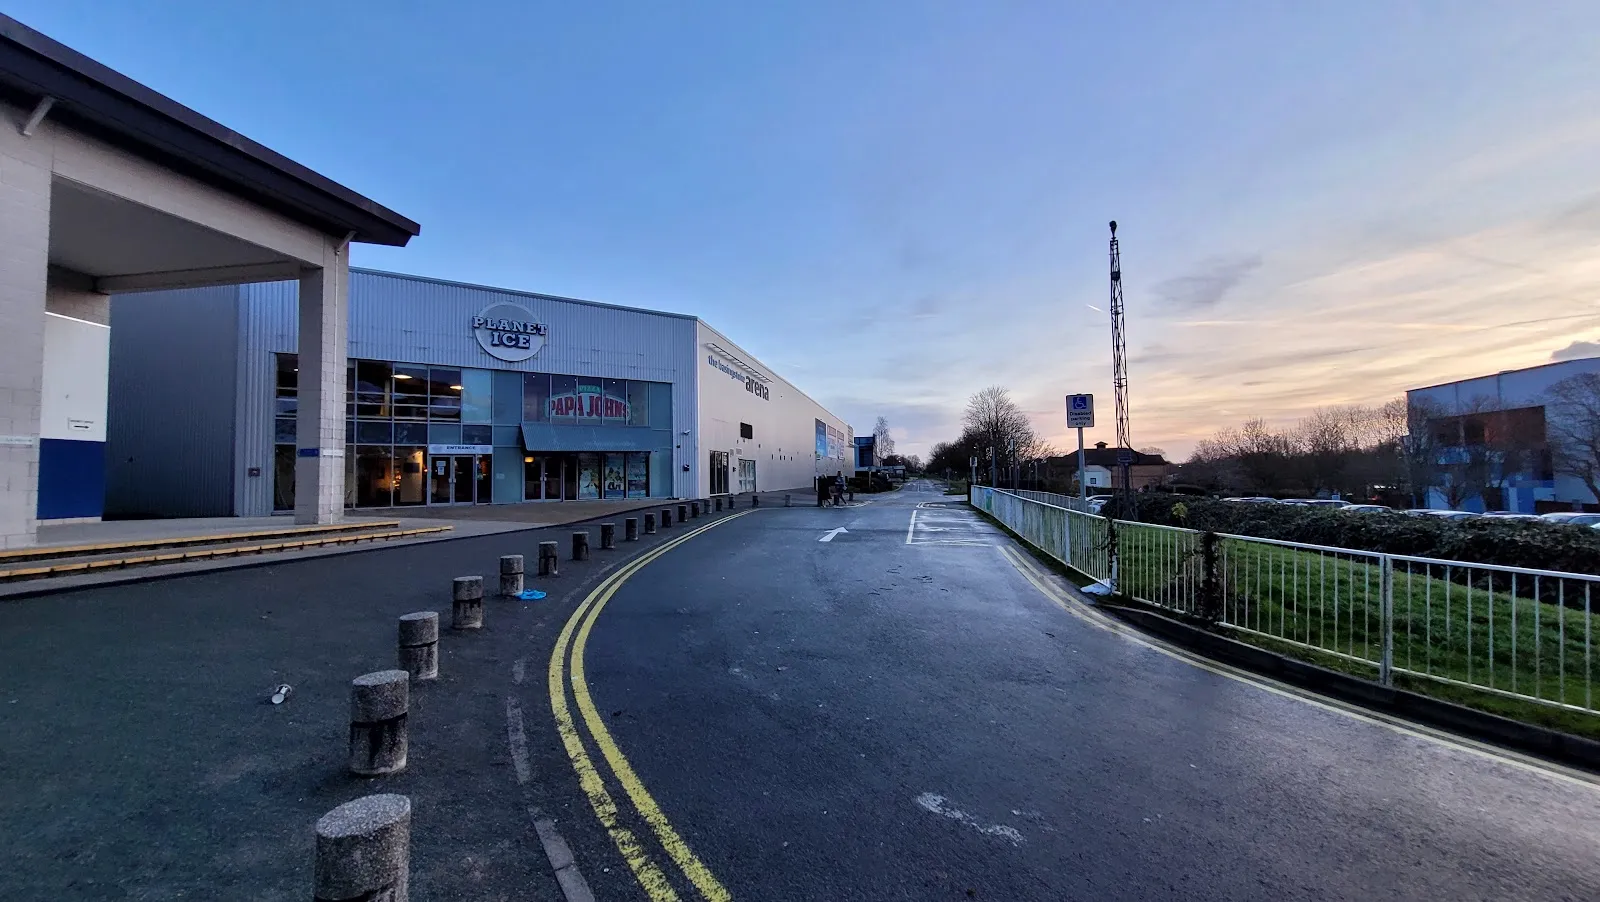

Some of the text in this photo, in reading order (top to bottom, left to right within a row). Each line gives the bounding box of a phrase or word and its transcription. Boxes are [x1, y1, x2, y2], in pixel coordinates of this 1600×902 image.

[472, 315, 548, 335] PLANET
[492, 331, 530, 349] ICE
[708, 355, 718, 369] the
[745, 375, 770, 402] arena
[550, 395, 585, 417] PAPA
